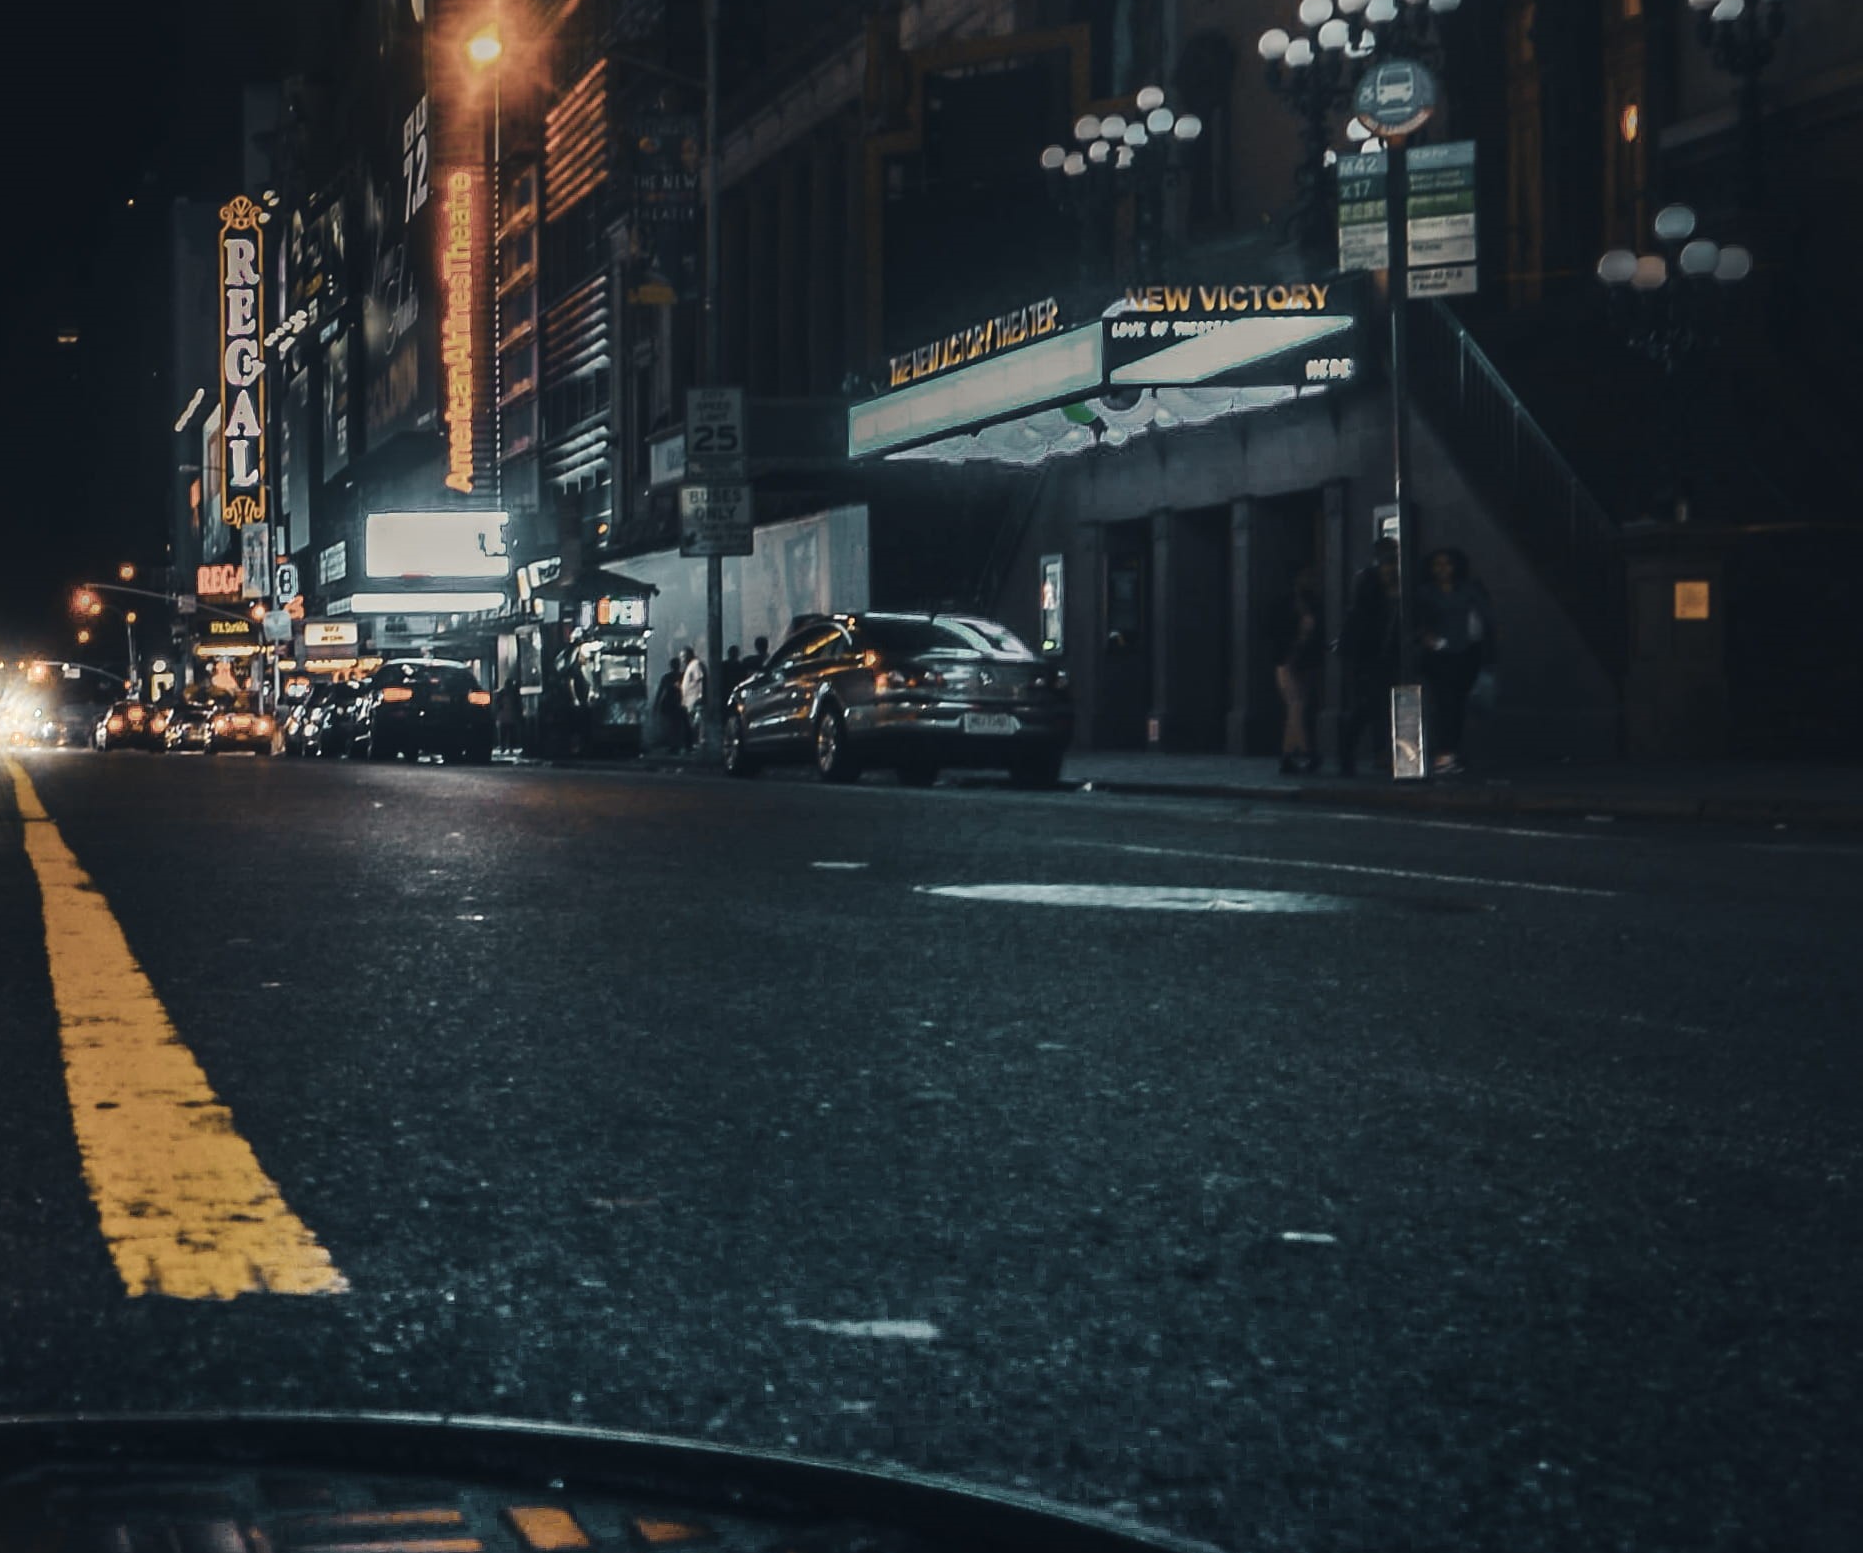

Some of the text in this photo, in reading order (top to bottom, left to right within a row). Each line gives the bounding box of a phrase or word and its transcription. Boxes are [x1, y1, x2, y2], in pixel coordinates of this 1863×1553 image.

[1124, 282, 1329, 312] NEW VICTORY
[993, 295, 1059, 349] THEATER
[223, 238, 265, 487] REGAL
[693, 425, 737, 453] 25
[689, 489, 742, 505] BUSES
[197, 564, 244, 595] REGA
